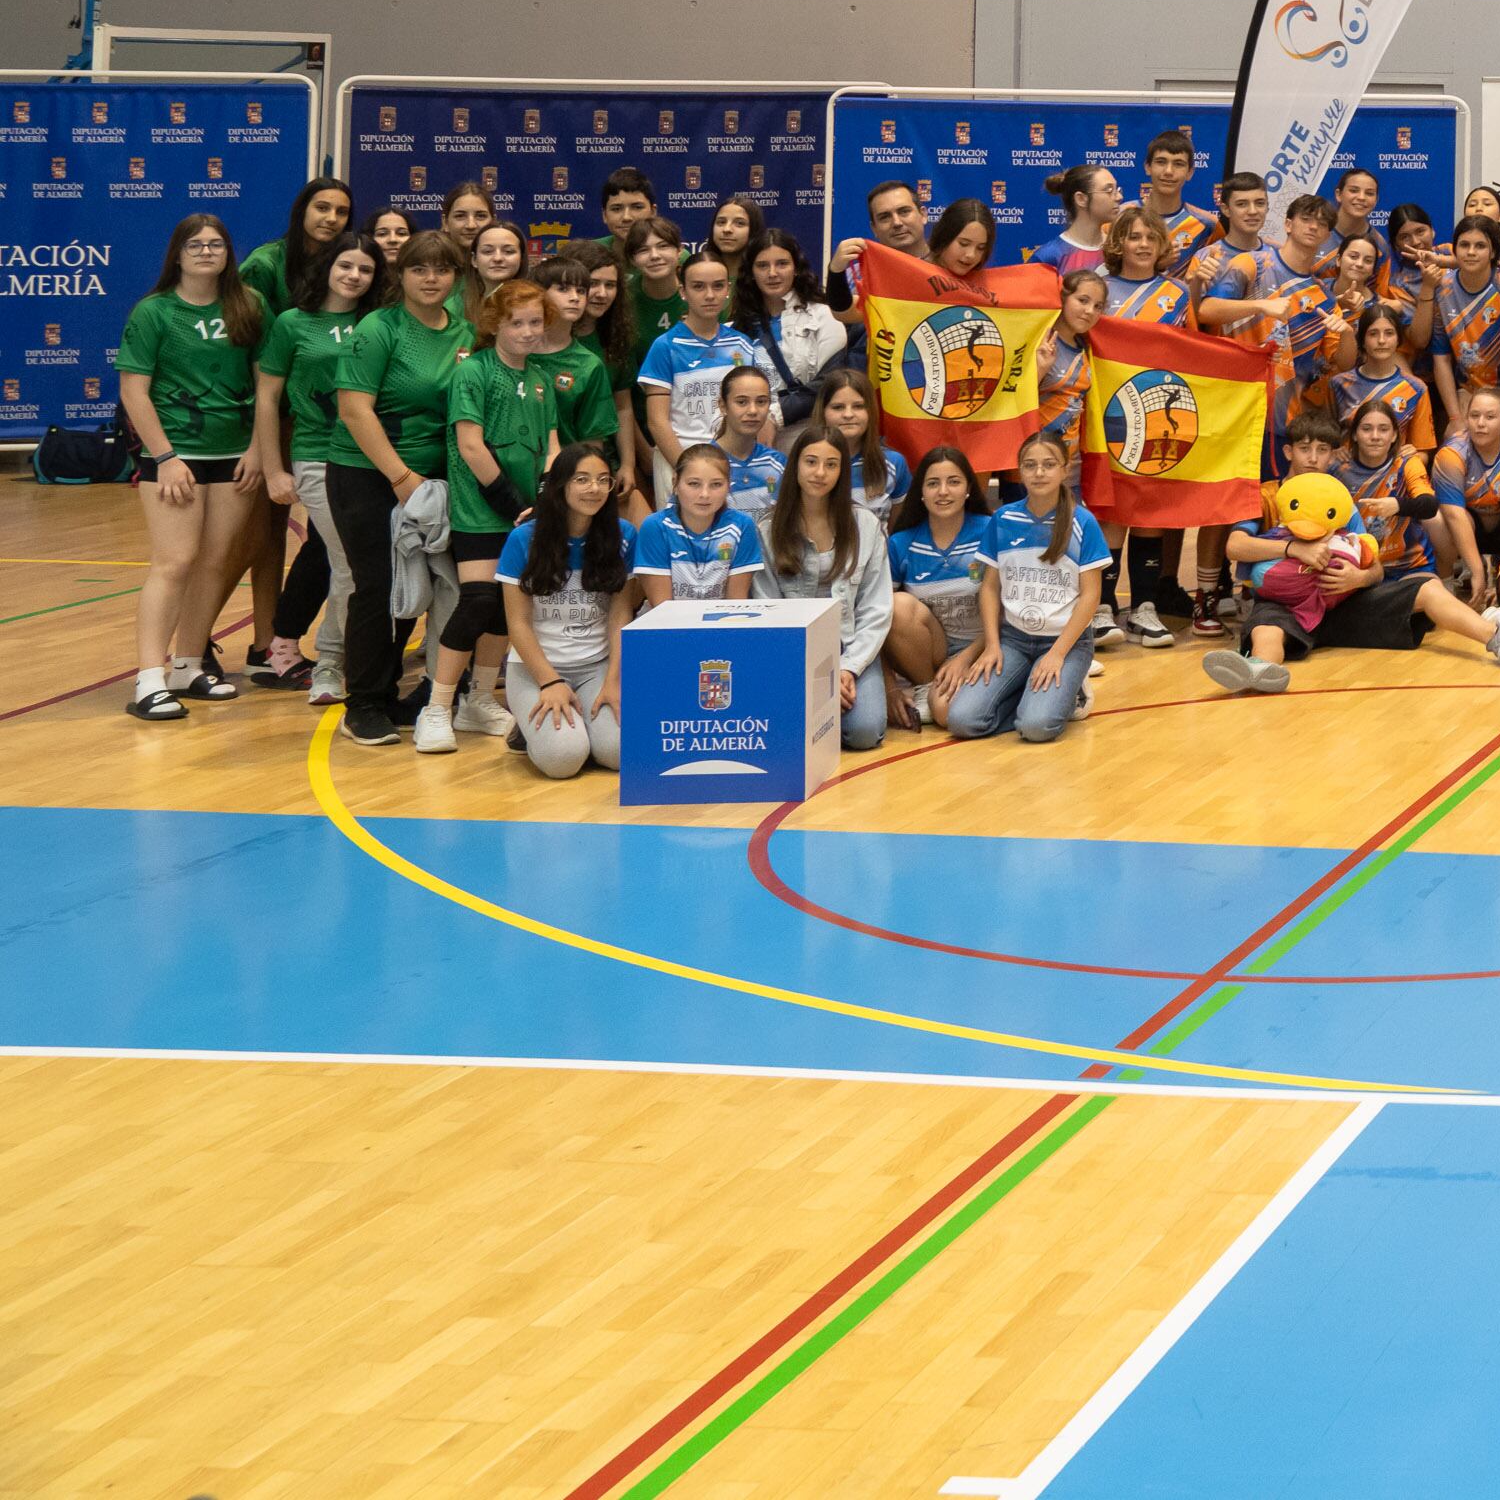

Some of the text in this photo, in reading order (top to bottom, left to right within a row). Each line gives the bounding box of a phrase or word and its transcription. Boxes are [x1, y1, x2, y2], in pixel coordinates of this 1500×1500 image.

[72, 127, 126, 135] DIPUTACIÓN
[228, 128, 280, 136] DIPUTACIÓN
[72, 134, 125, 143] DE ALMERÍA
[228, 134, 279, 144] DE ALMERÍA
[360, 135, 414, 143] DIPUTACIÓN
[1291, 98, 1345, 185] siempre
[375, 143, 413, 151] ALMERÍA
[863, 147, 913, 155] DIPUTACIÓN
[1012, 149, 1062, 158] DIPUTACIÓN
[1264, 120, 1310, 193] ORTE
[864, 154, 912, 164] DE ALMERÍA
[1012, 157, 1061, 166] DE ALMERÍA
[657, 312, 670, 329] 4
[194, 318, 228, 340] 12
[685, 381, 722, 397] CAFET
[1024, 587, 1067, 604] PLAZA
[661, 716, 769, 735] DIPUTACIÓN
[662, 734, 767, 752] DE ALMERÍA
